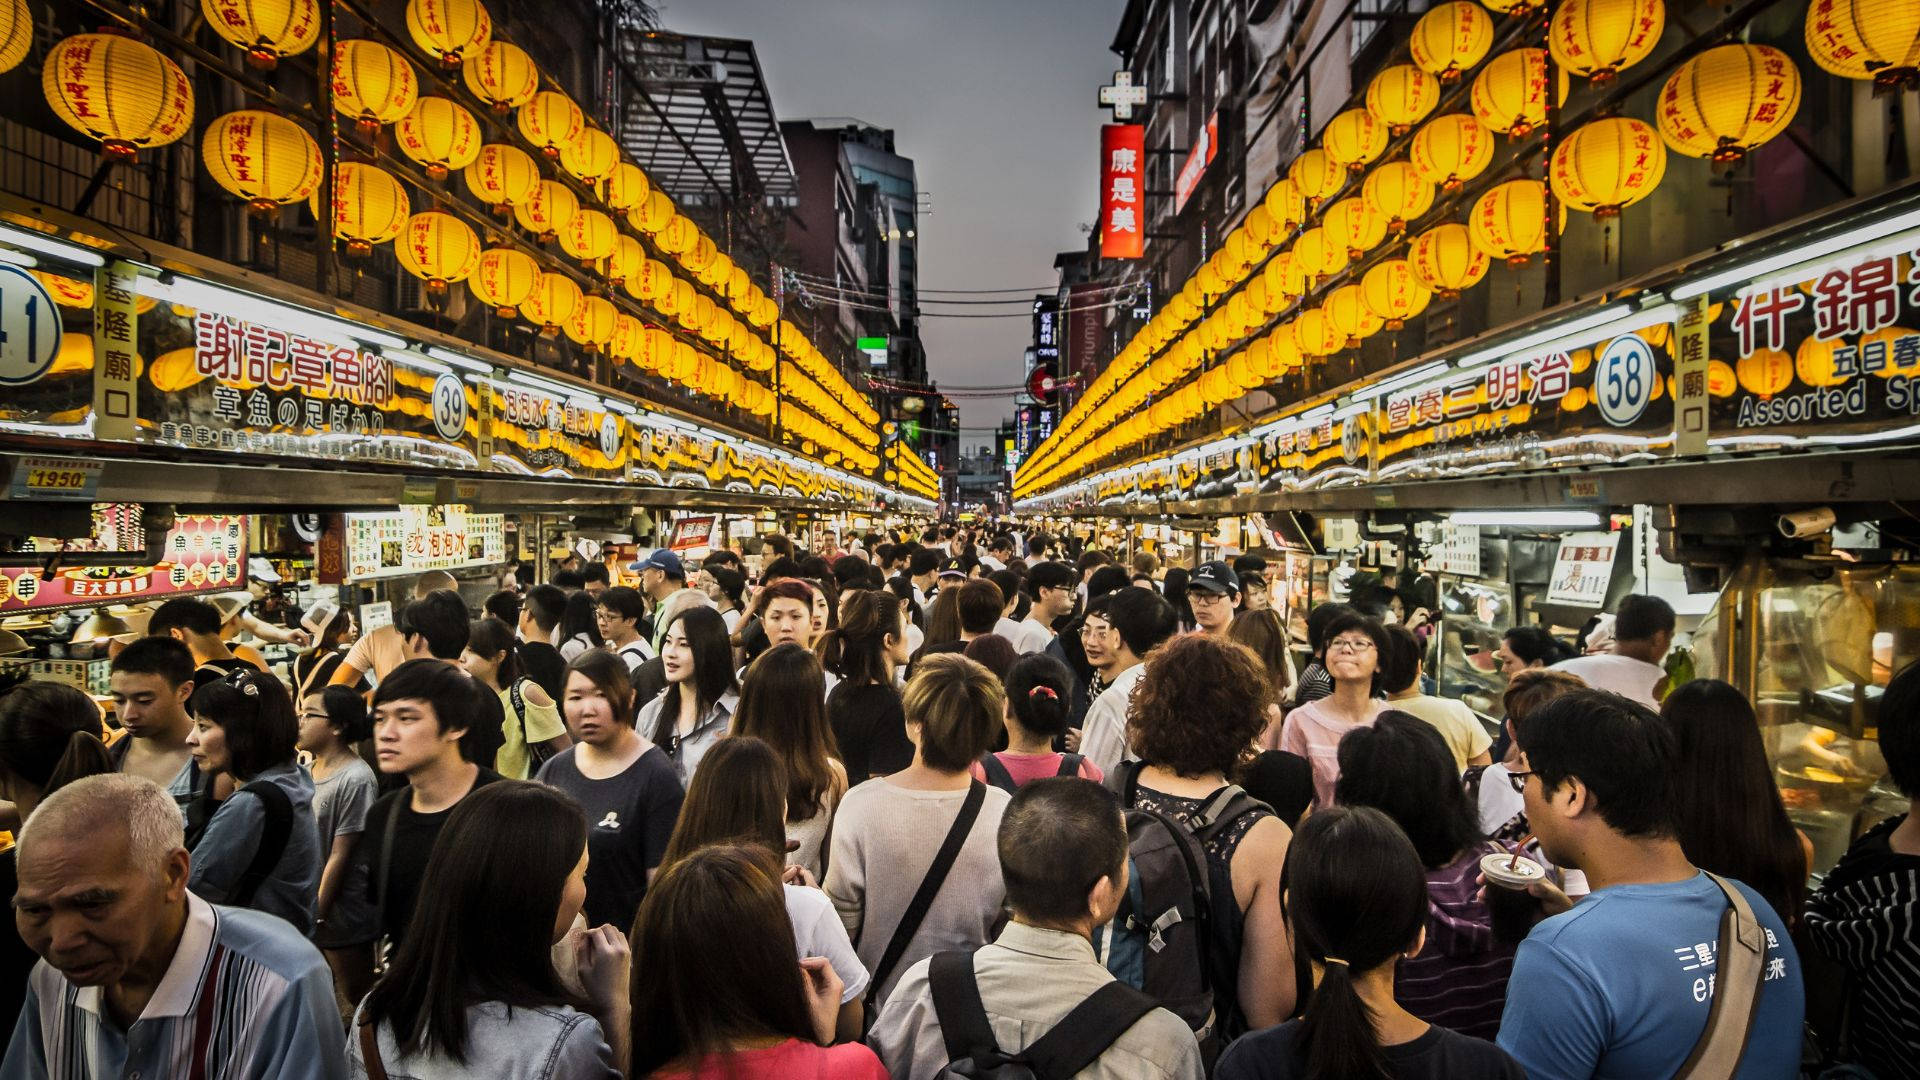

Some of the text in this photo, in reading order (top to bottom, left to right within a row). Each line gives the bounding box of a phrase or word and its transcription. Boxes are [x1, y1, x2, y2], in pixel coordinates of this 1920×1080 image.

[1110, 148, 1137, 232] 康是美
[0, 287, 37, 363] 1
[1734, 247, 1920, 356] 什錦
[103, 270, 132, 418] 基隆廟口
[198, 312, 395, 405] 謝記章魚腳
[1680, 297, 1705, 433] 基隆廟口
[440, 386, 463, 427] 39
[1606, 351, 1642, 409] 58
[1737, 378, 1866, 428] Assorted
[213, 386, 385, 437] 章魚の足ばかり
[604, 424, 617, 454] 37
[36, 471, 83, 487] 1950
[428, 530, 467, 558] 泡泡冰
